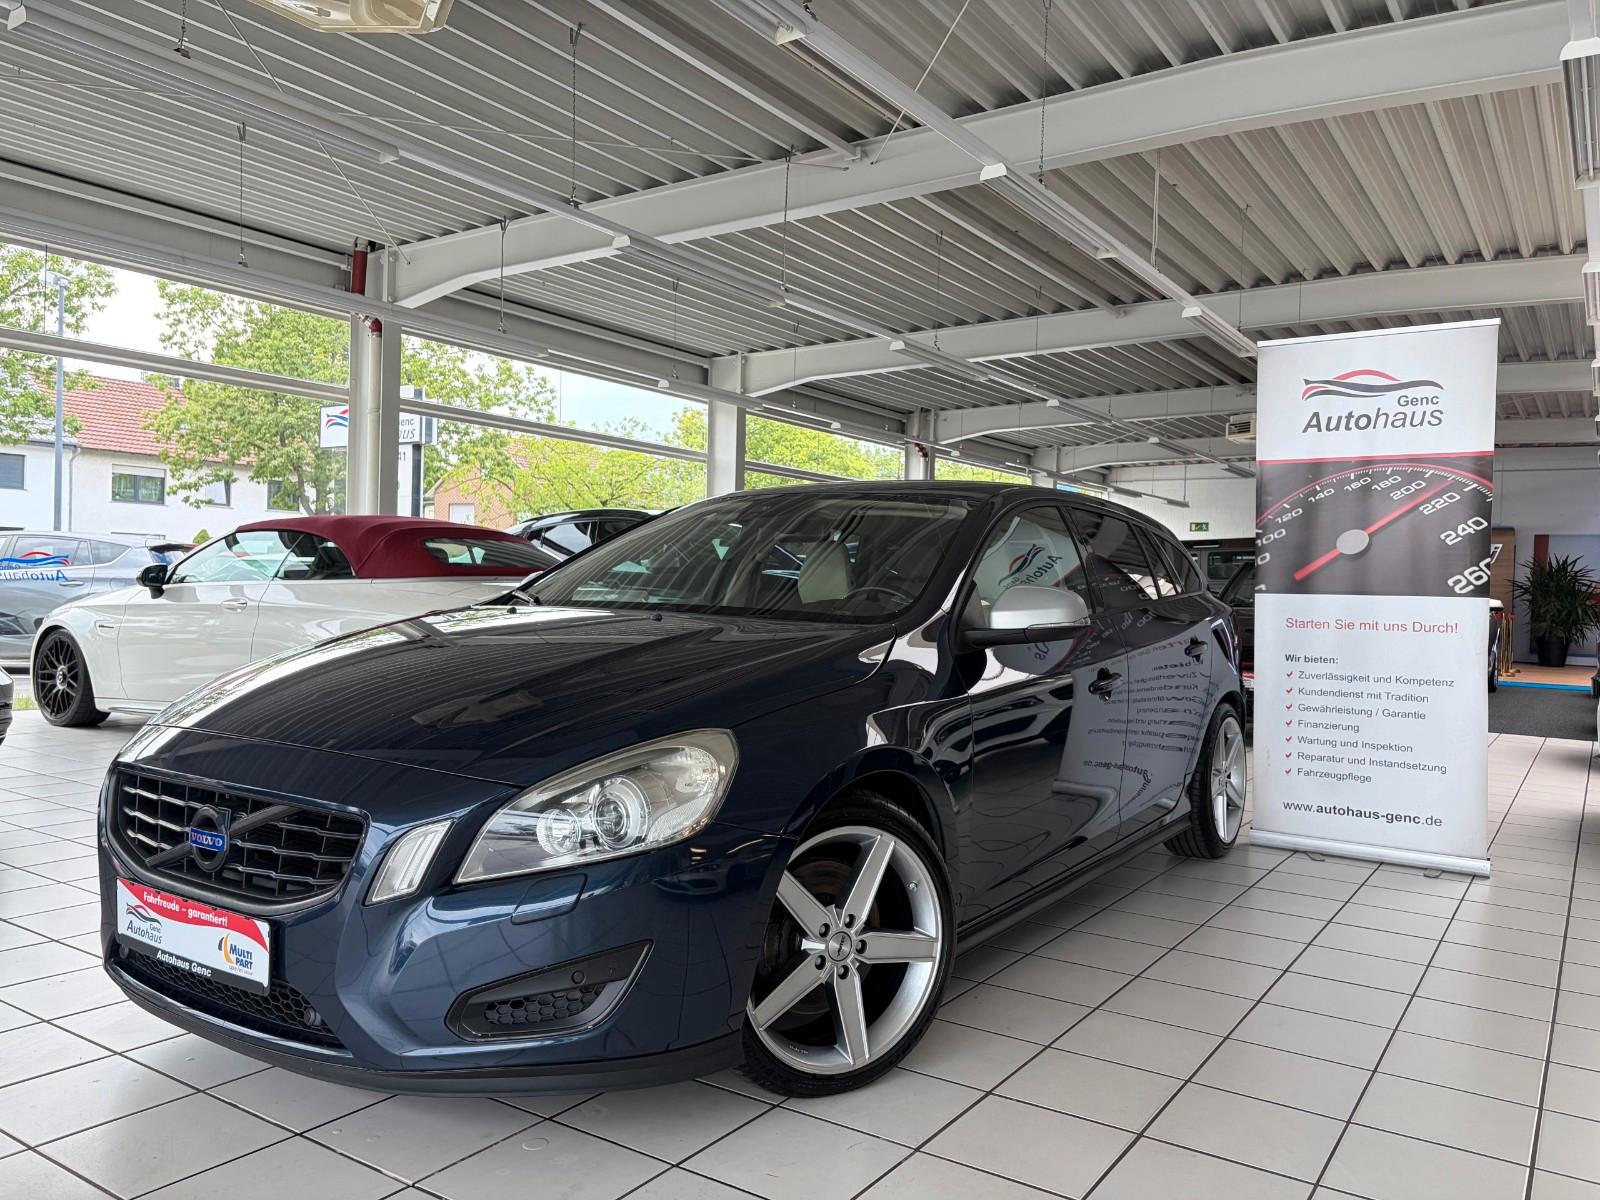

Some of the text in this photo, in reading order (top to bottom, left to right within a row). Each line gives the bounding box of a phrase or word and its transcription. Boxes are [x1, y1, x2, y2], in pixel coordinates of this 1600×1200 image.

[1397, 395, 1439, 407] Genc
[400, 418, 415, 426] enc
[1301, 408, 1444, 433] Autohaus
[1372, 475, 1402, 491] 180
[1390, 480, 1427, 500] 200
[1307, 488, 1335, 503] 140
[1418, 492, 1461, 515] 220
[1275, 508, 1303, 523] 120
[1255, 528, 1286, 547] 100
[1440, 517, 1488, 546] 240
[1255, 553, 1271, 567] 0
[1285, 617, 1459, 634] Starten Sie mit uns Durch!
[1285, 653, 1339, 665] Wir bieten:
[1298, 671, 1455, 688] Zuverlässigkeit und Kompetenz
[1298, 688, 1429, 703] Kundendienst mit Tradition
[1298, 703, 1427, 720] Gewährleistung / Garantie
[1298, 720, 1360, 733] Finanzierung
[1297, 736, 1413, 753] Wartung und Inspektion
[1297, 752, 1448, 774] Reparatur und Instandsetzung
[1297, 768, 1372, 784] Fahrzeugpflege
[1283, 801, 1443, 828] www.autohaus-genc.de
[191, 831, 224, 847] VOLVO
[143, 891, 180, 912] Fahrfreude
[187, 907, 228, 926] garantiert!
[127, 920, 163, 944] Autohaus
[229, 944, 252, 960] MULTI
[157, 950, 190, 970] Autohaus
[191, 962, 212, 977] Genc
[235, 957, 253, 970] PART
